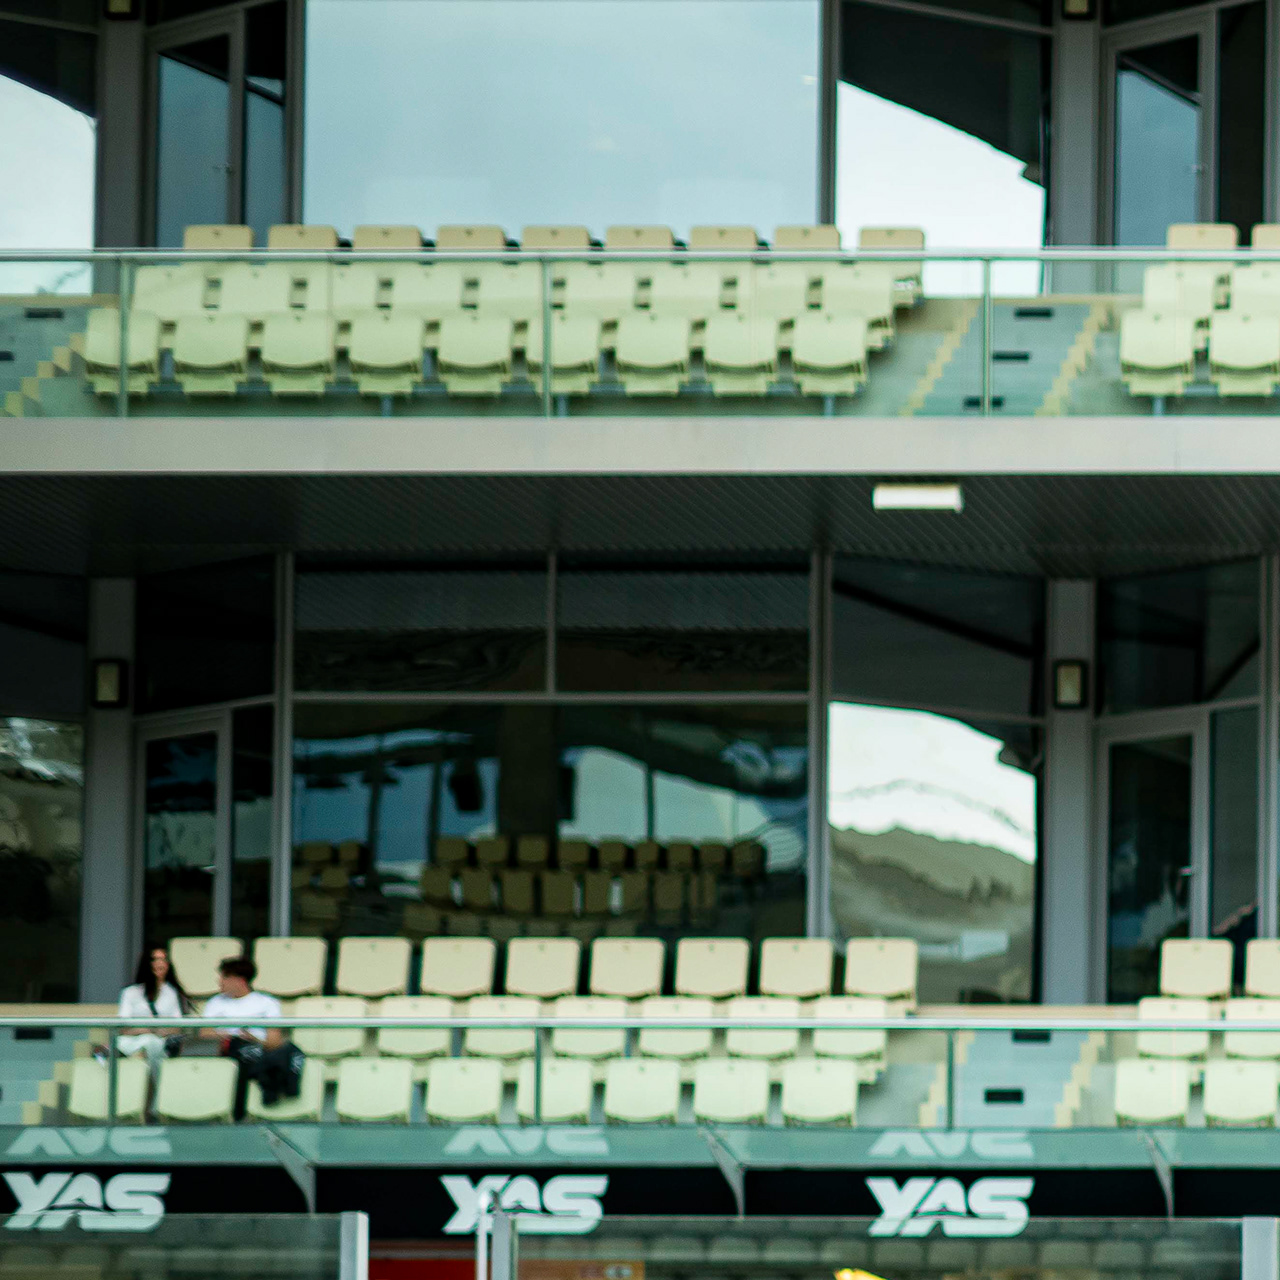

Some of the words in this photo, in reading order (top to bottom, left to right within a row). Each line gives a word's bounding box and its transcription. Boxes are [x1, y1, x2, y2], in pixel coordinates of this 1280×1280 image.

[2, 1173, 171, 1232] YAS
[440, 1176, 608, 1235] YAS
[866, 1178, 1034, 1236] YAS
